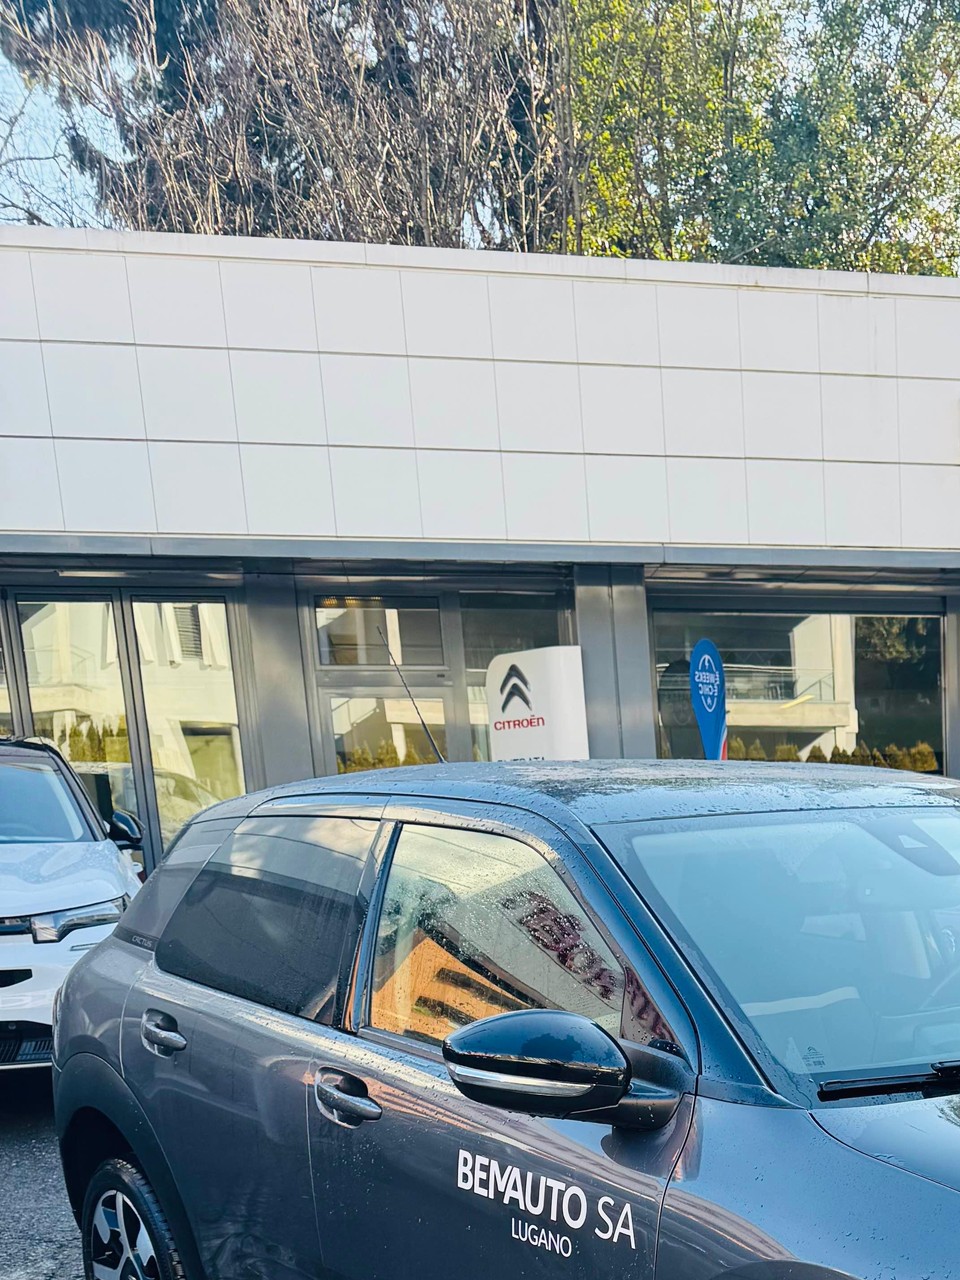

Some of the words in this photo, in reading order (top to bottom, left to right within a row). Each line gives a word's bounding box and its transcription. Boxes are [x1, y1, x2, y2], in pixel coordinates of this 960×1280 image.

[457, 1149, 588, 1230] BEMAUTO
[594, 1195, 636, 1250] SA
[511, 1217, 573, 1258] LUGANO
